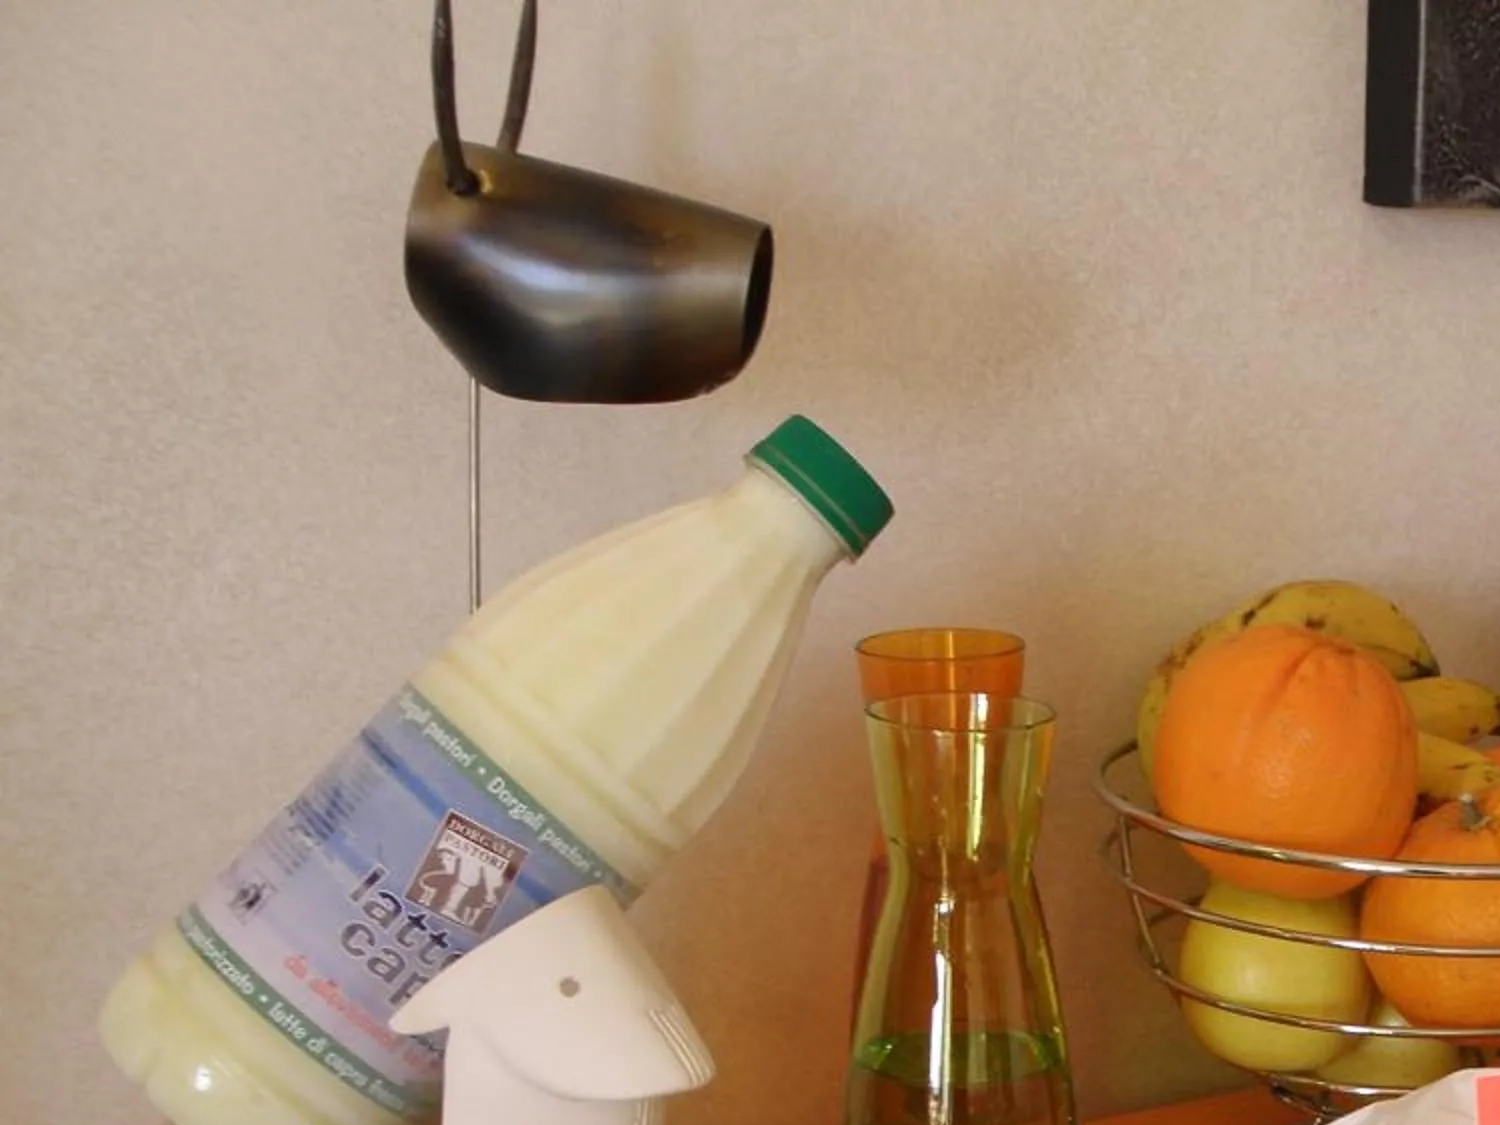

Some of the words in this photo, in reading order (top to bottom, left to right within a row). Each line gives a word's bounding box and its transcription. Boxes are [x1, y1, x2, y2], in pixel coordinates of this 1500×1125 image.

[486, 776, 546, 836] Dorgali
[339, 919, 434, 1006] cap
[268, 1001, 308, 1040] latte
